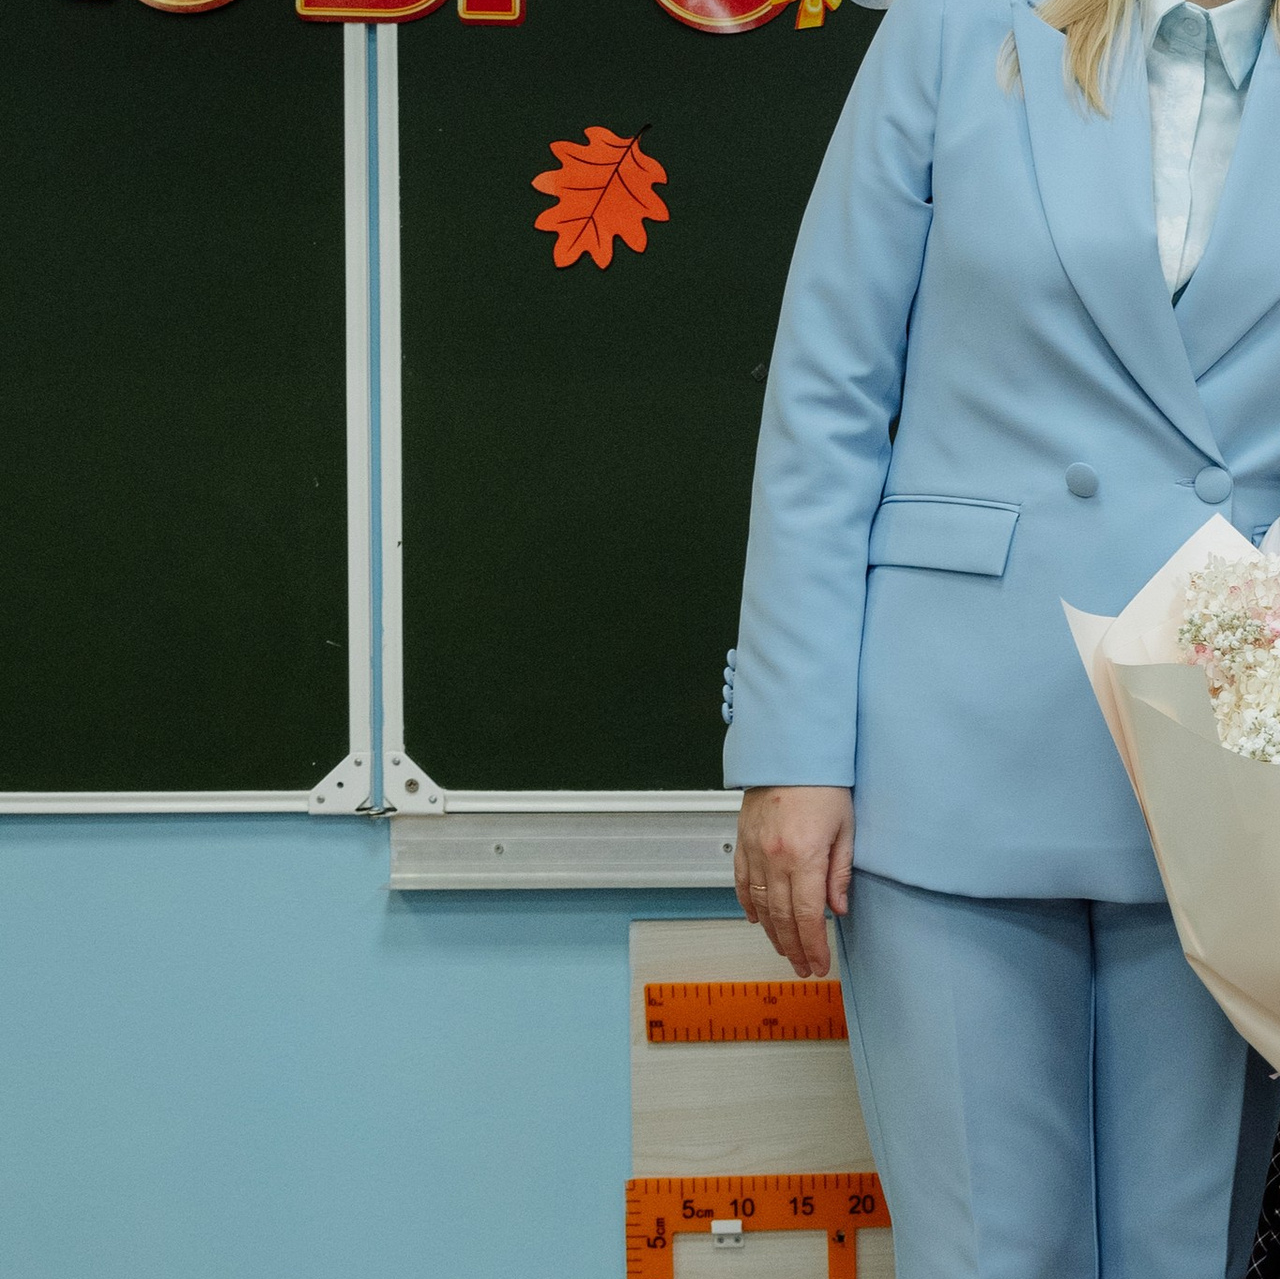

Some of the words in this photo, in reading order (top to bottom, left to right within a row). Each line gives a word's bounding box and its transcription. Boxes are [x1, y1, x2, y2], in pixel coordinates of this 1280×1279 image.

[682, 1200, 715, 1219] 5cm
[730, 1198, 756, 1218] 10
[789, 1196, 815, 1217] 15
[848, 1195, 876, 1216] 20
